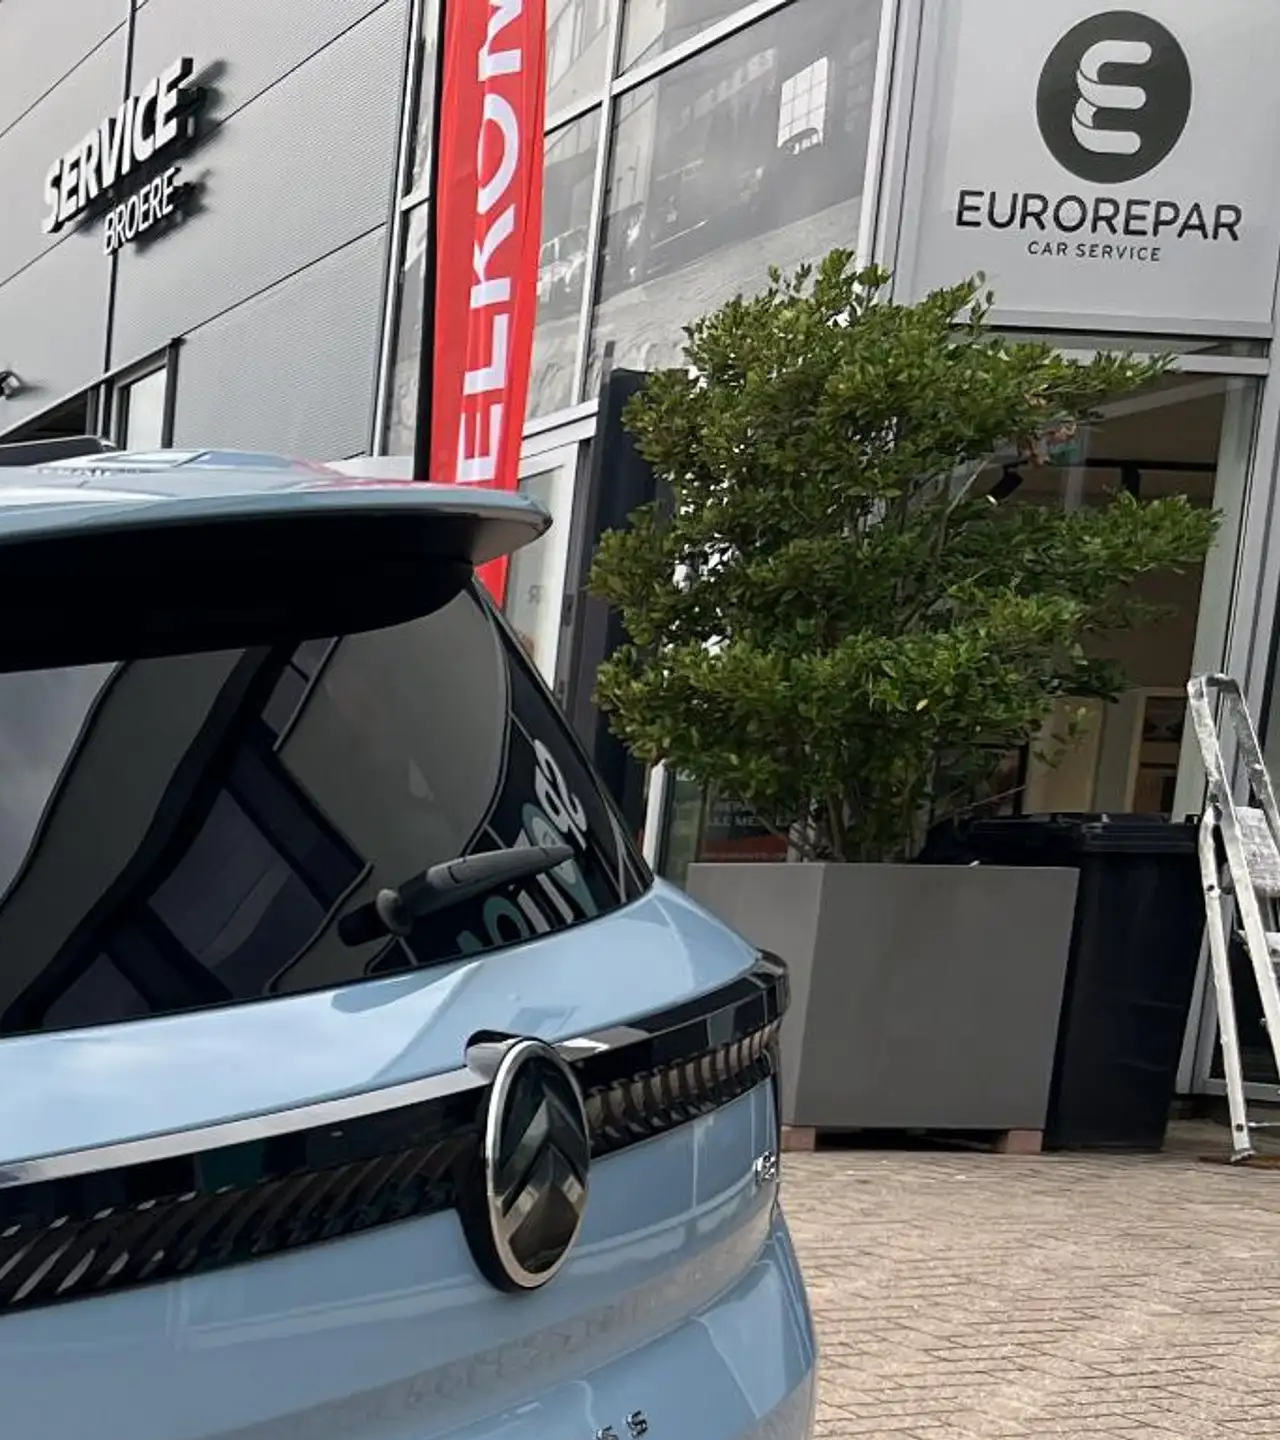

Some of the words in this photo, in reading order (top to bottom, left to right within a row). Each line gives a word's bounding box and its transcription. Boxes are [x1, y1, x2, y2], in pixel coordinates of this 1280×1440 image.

[41, 57, 185, 233] SERVICE
[104, 166, 178, 256] BROERE
[955, 189, 1243, 242] EUROREPAR
[1027, 240, 1069, 256] CAR
[1075, 242, 1162, 262] SERVICE
